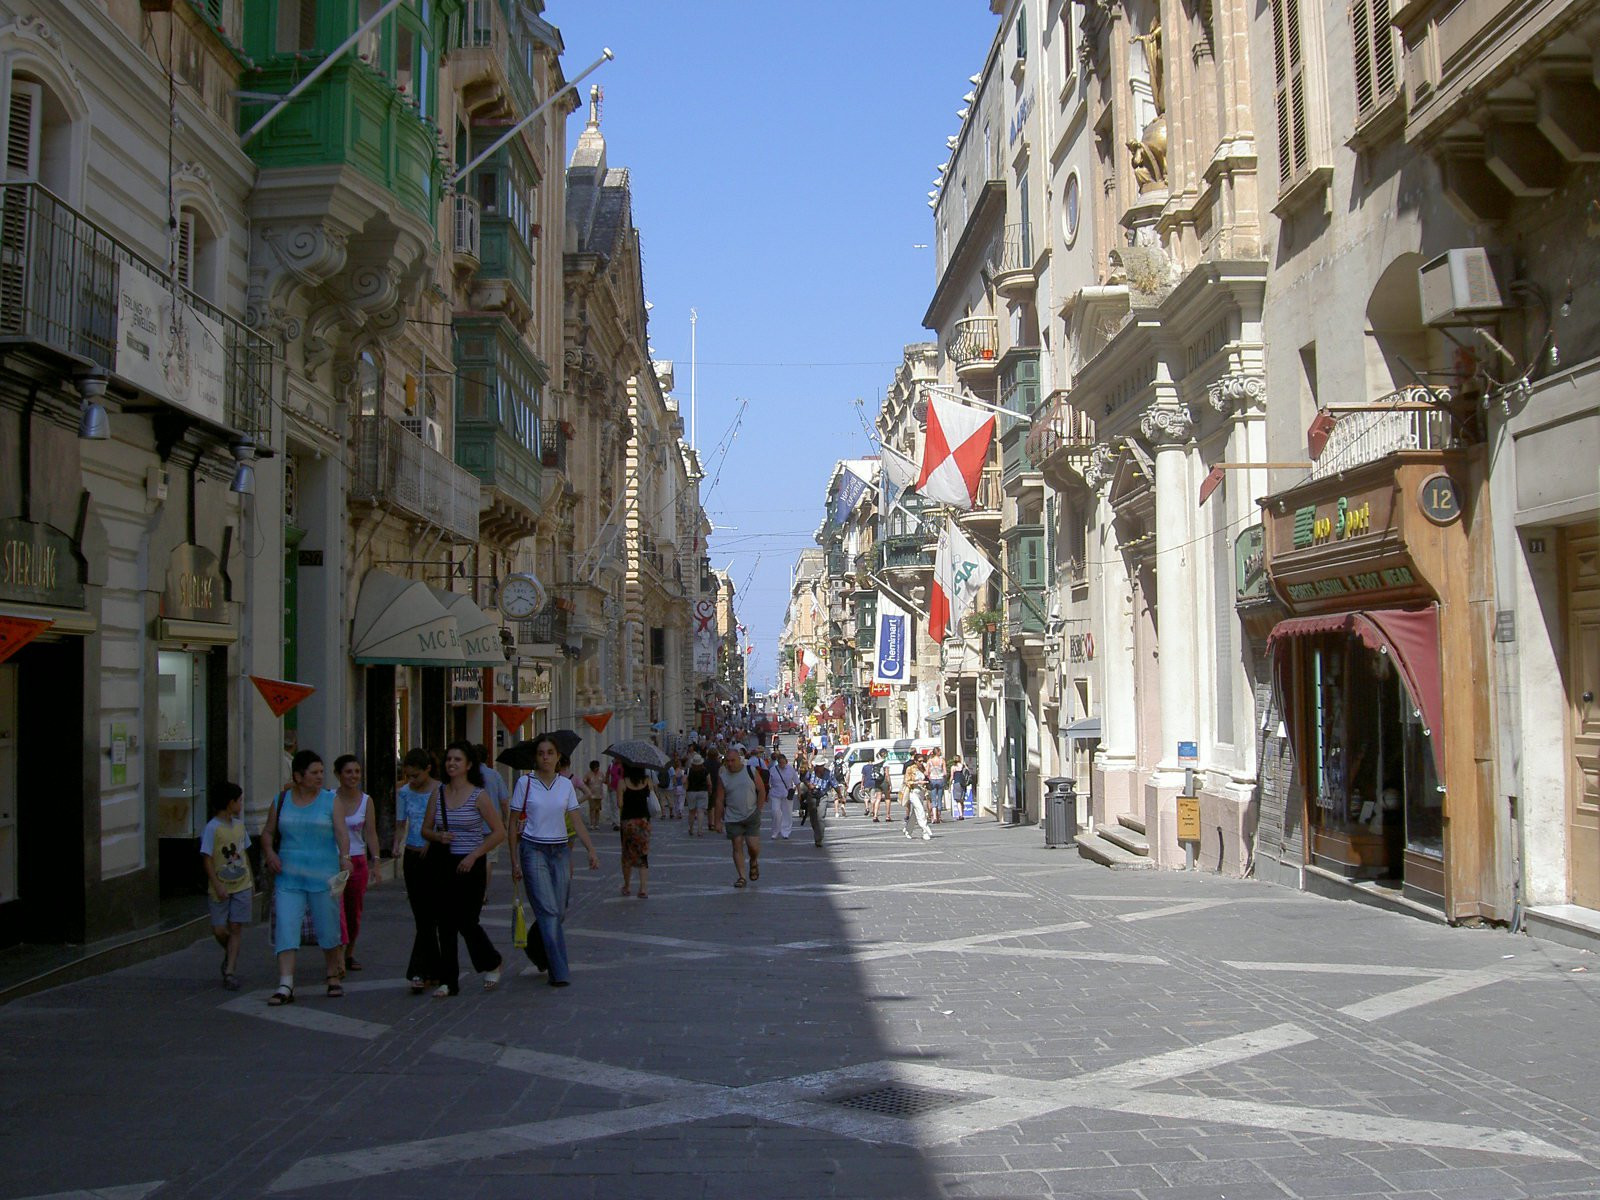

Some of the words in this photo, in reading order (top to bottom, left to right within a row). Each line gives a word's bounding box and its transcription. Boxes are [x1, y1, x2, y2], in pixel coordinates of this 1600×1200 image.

[1432, 488, 1452, 509] 12
[1335, 496, 1370, 542] Sport
[4, 540, 57, 591] STERLING
[1287, 583, 1316, 600] SPORTS
[1315, 577, 1347, 596] CASUAL
[1355, 572, 1383, 590] FOOT
[1381, 567, 1414, 586] WEAR
[417, 629, 447, 652] MC
[466, 637, 490, 656] MC
[880, 619, 901, 677] Chemimart
[1070, 634, 1085, 657] HSBC
